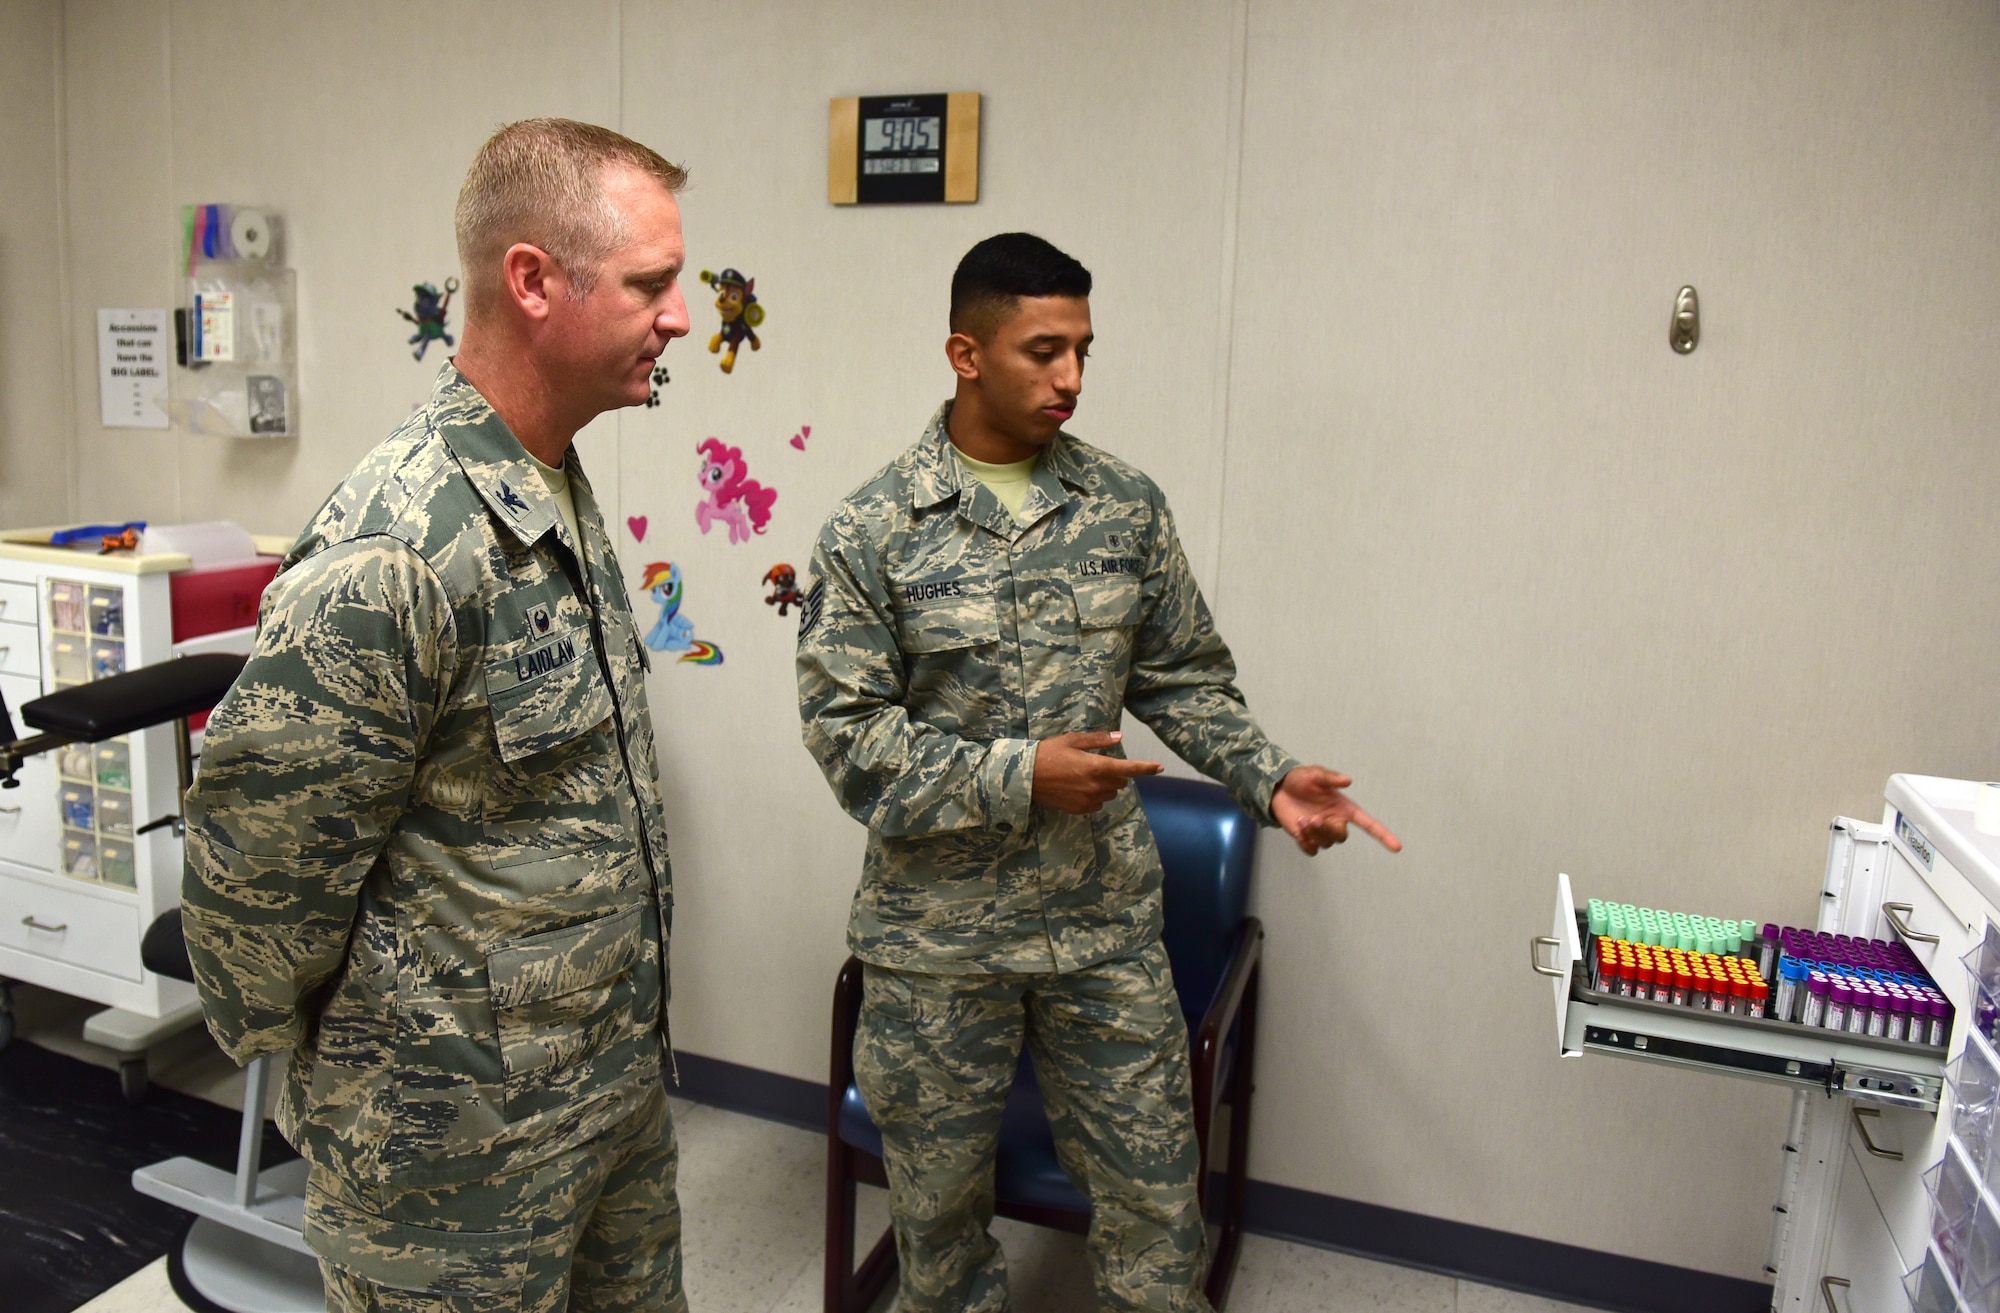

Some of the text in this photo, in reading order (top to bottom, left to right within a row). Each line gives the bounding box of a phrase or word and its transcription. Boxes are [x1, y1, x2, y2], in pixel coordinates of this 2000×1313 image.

[882, 117, 930, 151] 9:05
[116, 338, 152, 348] that can
[116, 353, 153, 362] have the
[111, 367, 128, 377] BIG
[1079, 560, 1100, 576] U.S.
[1101, 559, 1118, 575] AIR
[906, 580, 961, 603] HUGHES
[515, 637, 576, 681] LAIDLAW
[1906, 826, 1931, 864] Waterloo
